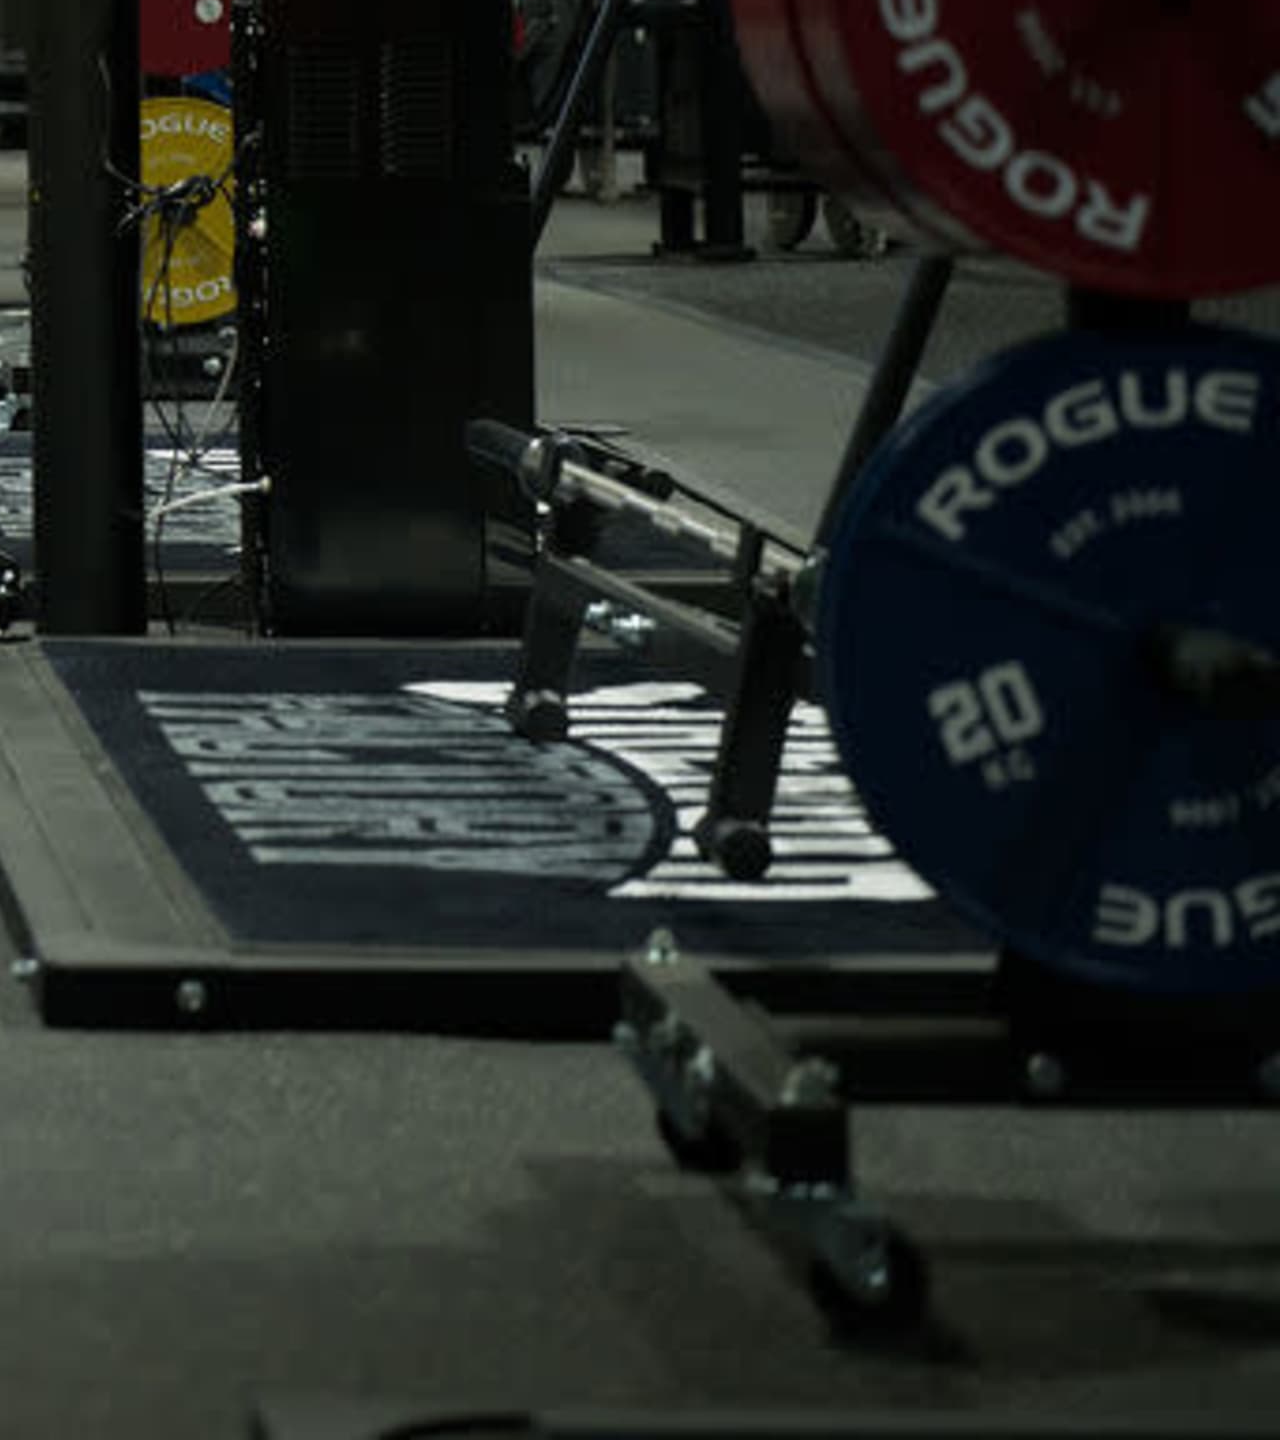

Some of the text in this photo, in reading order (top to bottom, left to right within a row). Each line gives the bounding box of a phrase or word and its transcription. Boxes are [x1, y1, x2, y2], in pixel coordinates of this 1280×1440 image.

[139, 112, 230, 144] OGUE
[915, 367, 1262, 543] ROGUE
[927, 658, 1045, 767] 20
[1092, 872, 1280, 950] GUE
